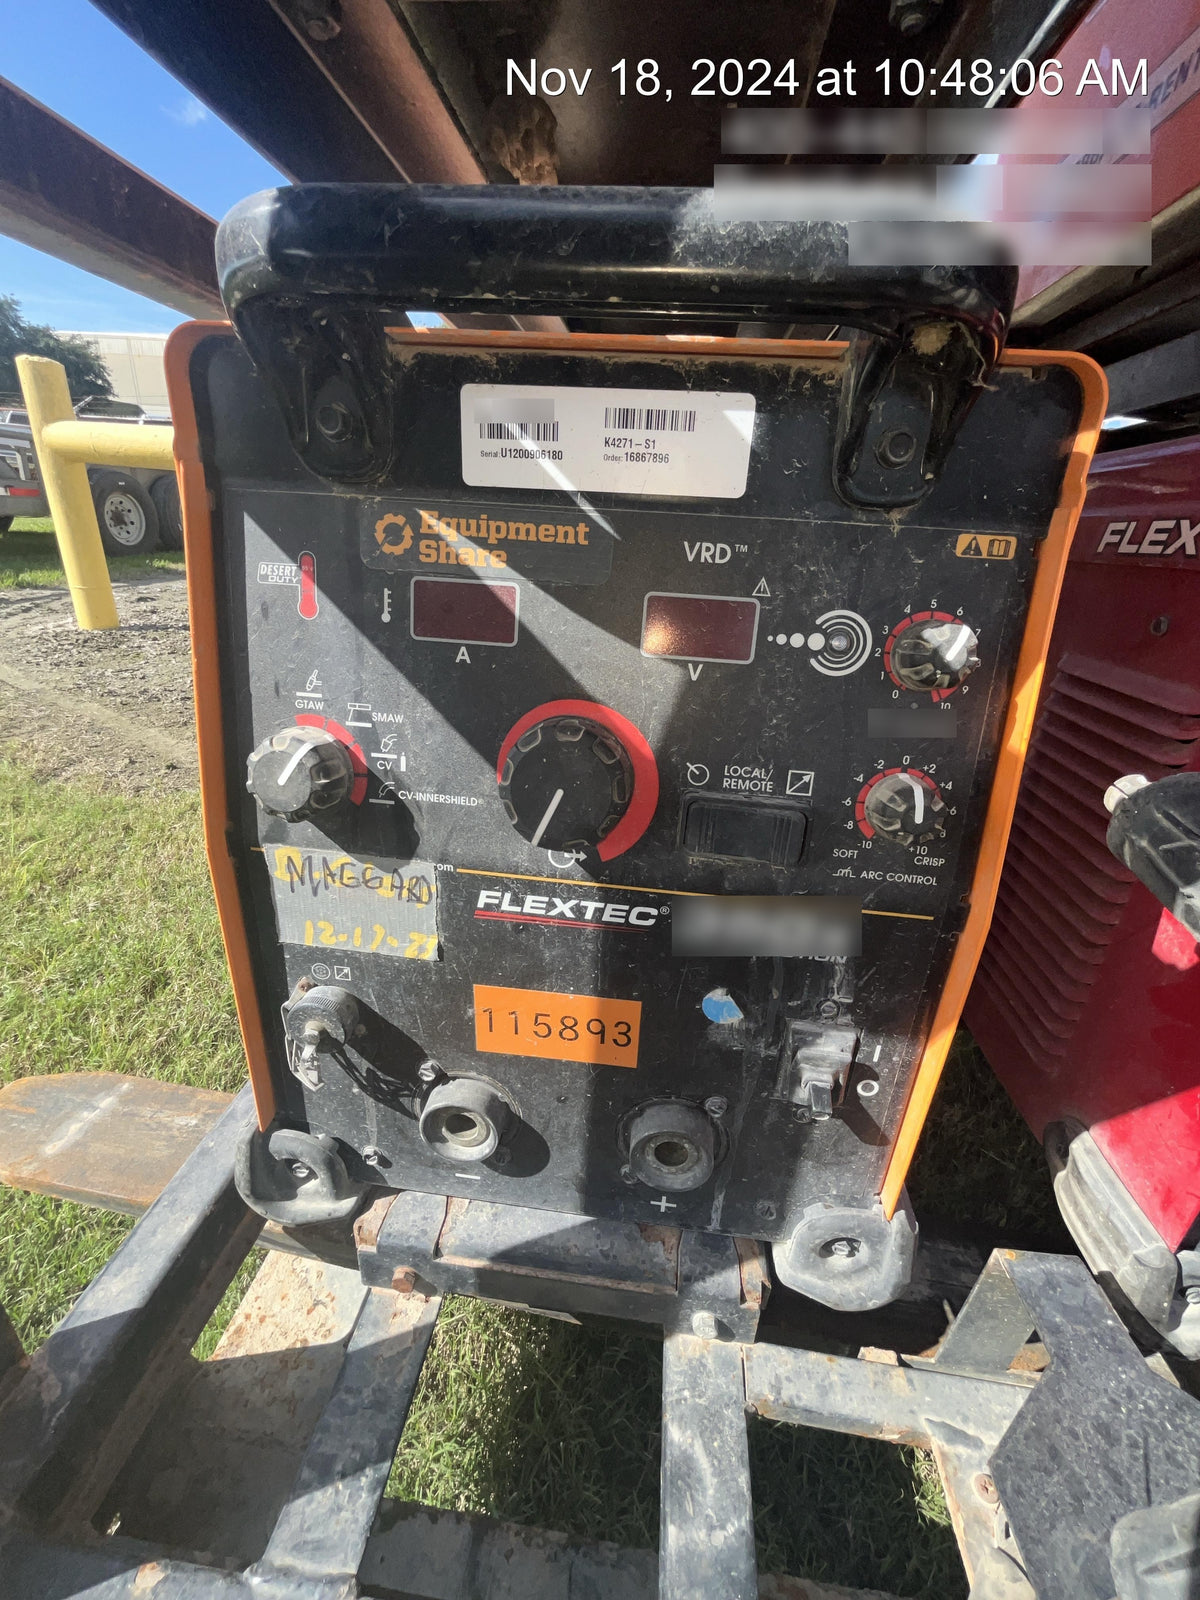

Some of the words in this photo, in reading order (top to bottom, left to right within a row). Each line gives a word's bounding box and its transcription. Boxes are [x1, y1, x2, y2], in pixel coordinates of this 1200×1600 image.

[624, 451, 670, 464] 16867896
[419, 509, 590, 546] Equipment
[418, 539, 508, 569] Share
[260, 564, 297, 577] DESERT
[268, 575, 299, 584] DUTY
[903, 604, 912, 614] 4
[931, 599, 938, 609] 5
[956, 606, 964, 616] 6
[882, 625, 889, 635] 3
[455, 647, 471, 664] A
[874, 647, 882, 657] 2
[687, 662, 704, 682] V
[891, 689, 899, 699] 0
[962, 685, 969, 695] 9
[295, 699, 324, 711] GTAW
[371, 711, 404, 724] SMAW
[377, 760, 393, 771] CV
[873, 759, 885, 770] -2
[902, 755, 910, 766] 0
[724, 764, 774, 782] LOCAL/
[922, 763, 937, 775] +2
[853, 773, 865, 783] -4
[722, 778, 774, 793] REMOTE
[939, 780, 953, 791] +4
[841, 796, 852, 807] -6
[843, 820, 855, 831] -8
[857, 841, 873, 850] -10
[908, 846, 928, 856] +10
[832, 848, 859, 860] SOFT
[914, 856, 946, 868] CRISP
[860, 870, 884, 882] ARC
[886, 872, 938, 887] CONTROL
[482, 1007, 633, 1048] 115893
